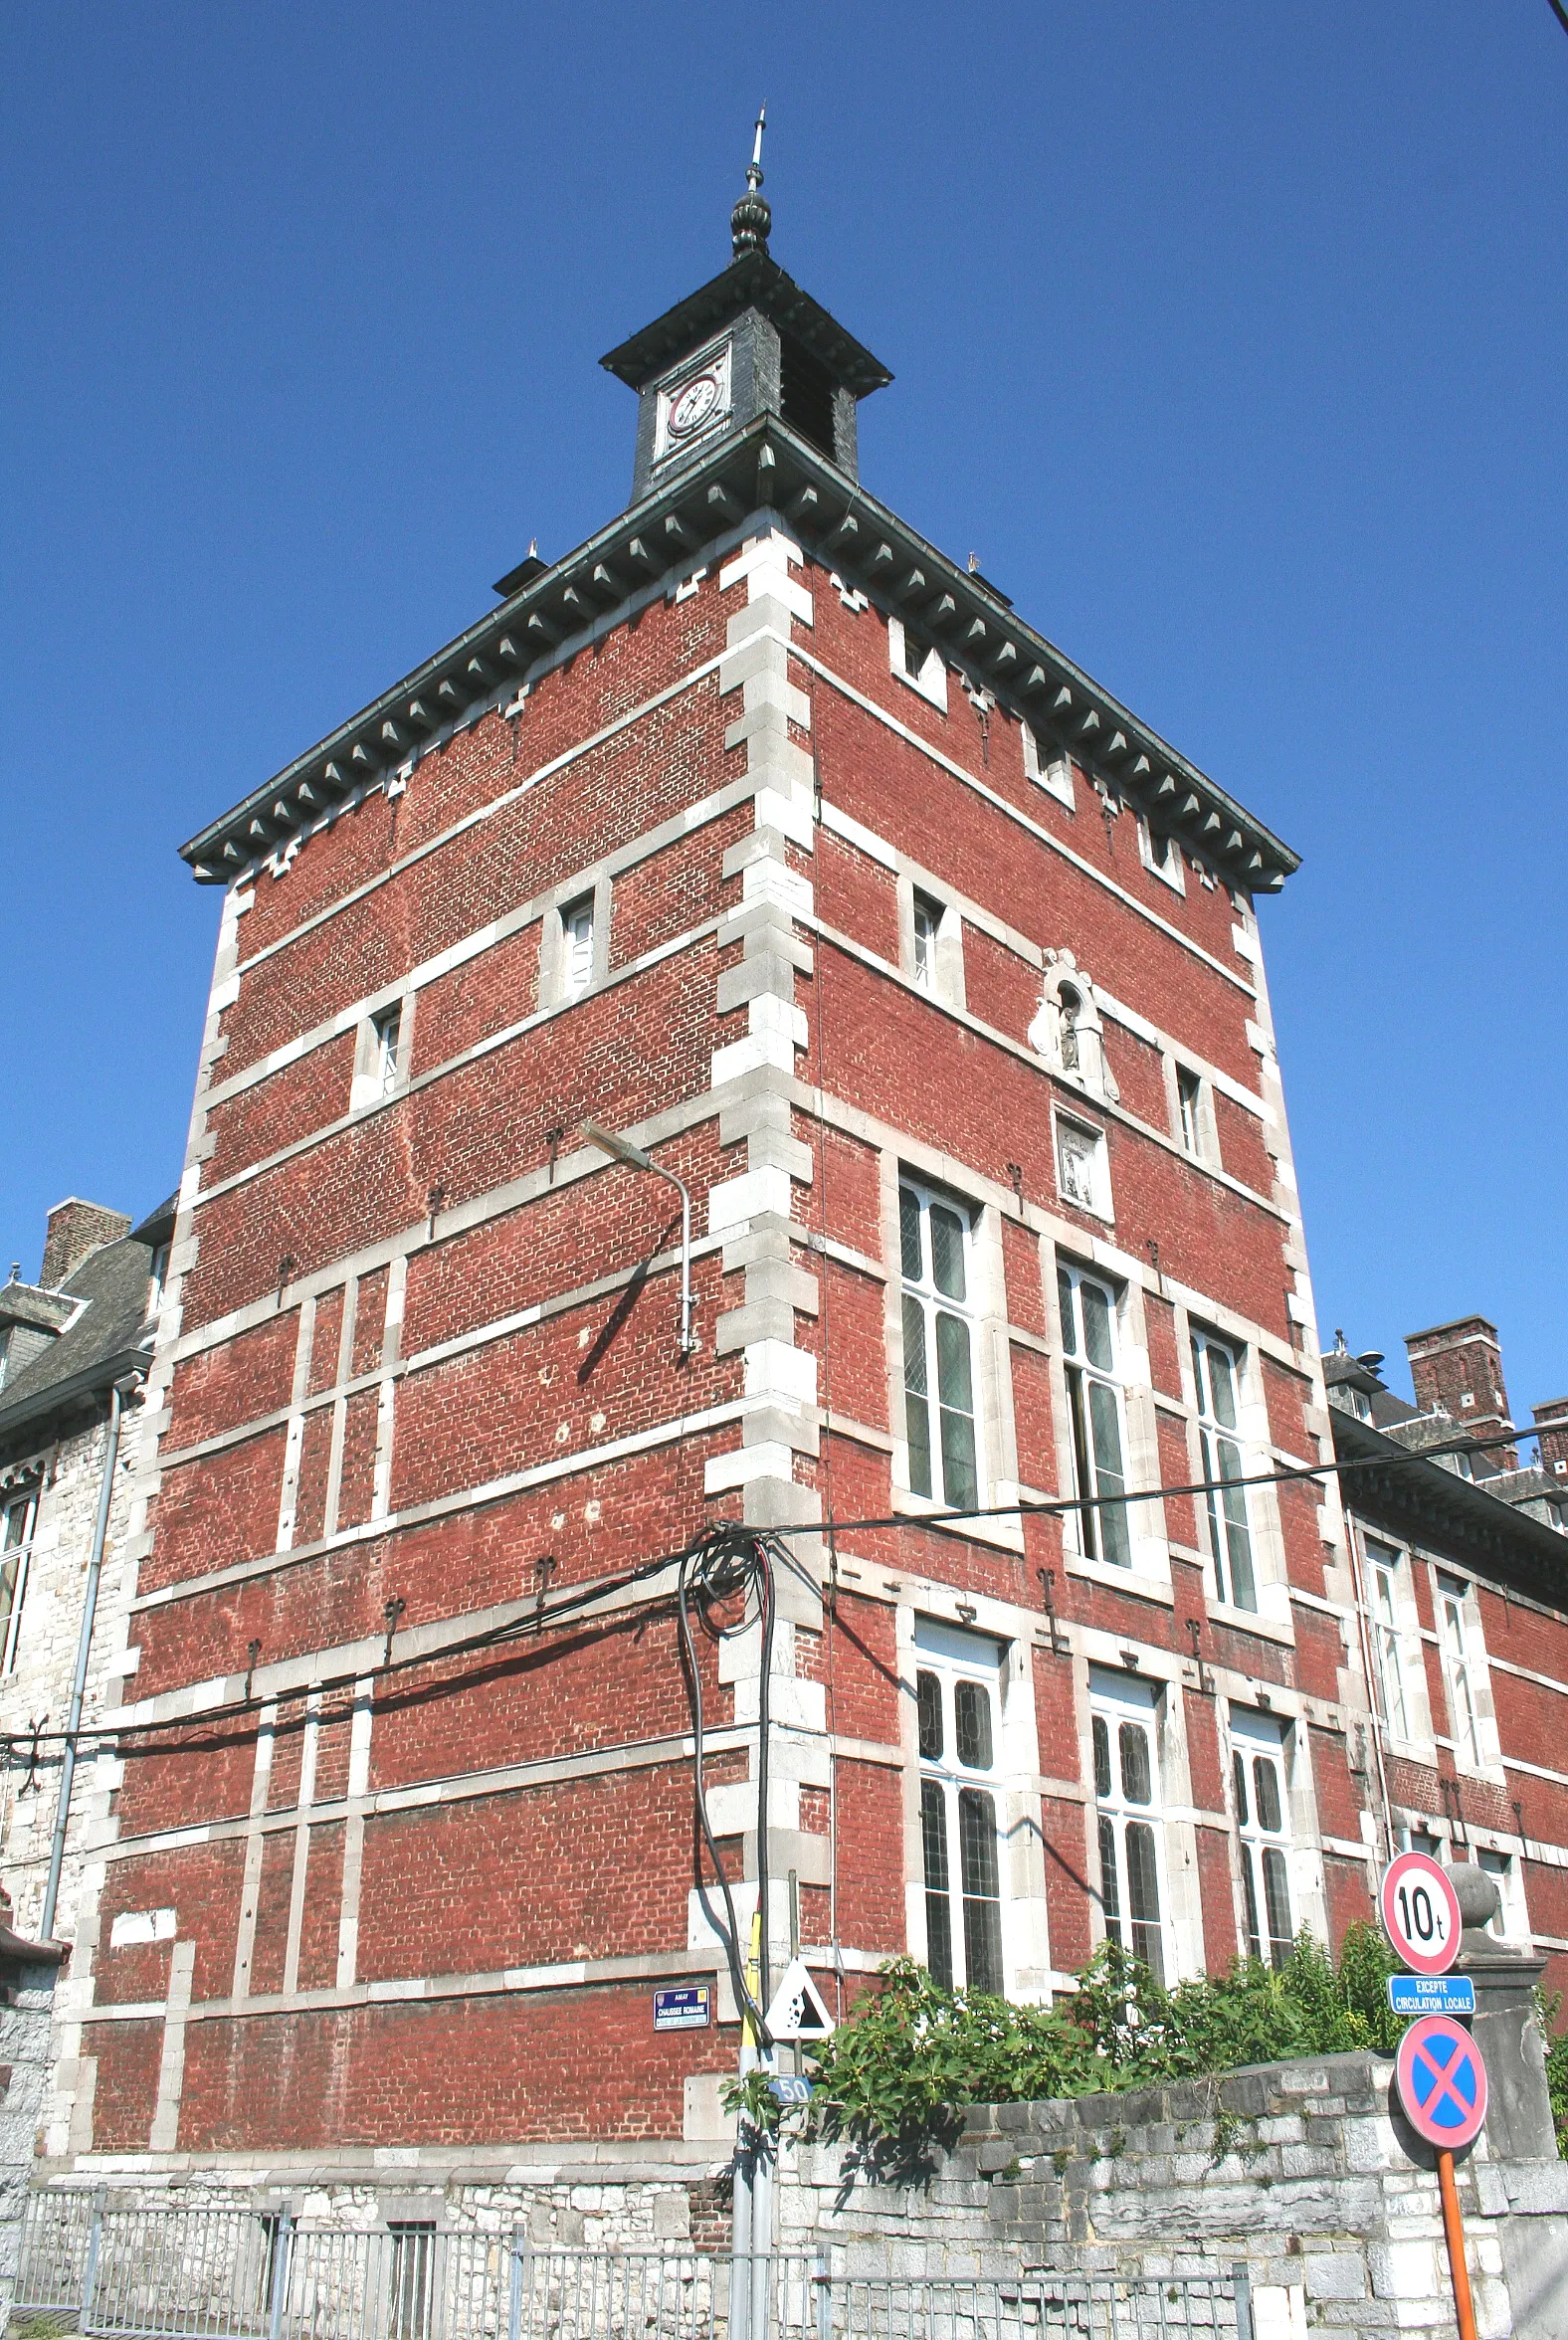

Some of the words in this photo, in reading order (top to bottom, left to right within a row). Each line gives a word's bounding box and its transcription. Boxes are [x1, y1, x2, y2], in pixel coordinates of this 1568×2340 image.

[1416, 1981, 1449, 1994] EXCEPTE
[683, 2005, 705, 2014] ROMAINE
[1396, 1997, 1442, 2010] CIRCULATION
[1444, 1997, 1471, 2010] LOCALE
[778, 2079, 809, 2101] 50
